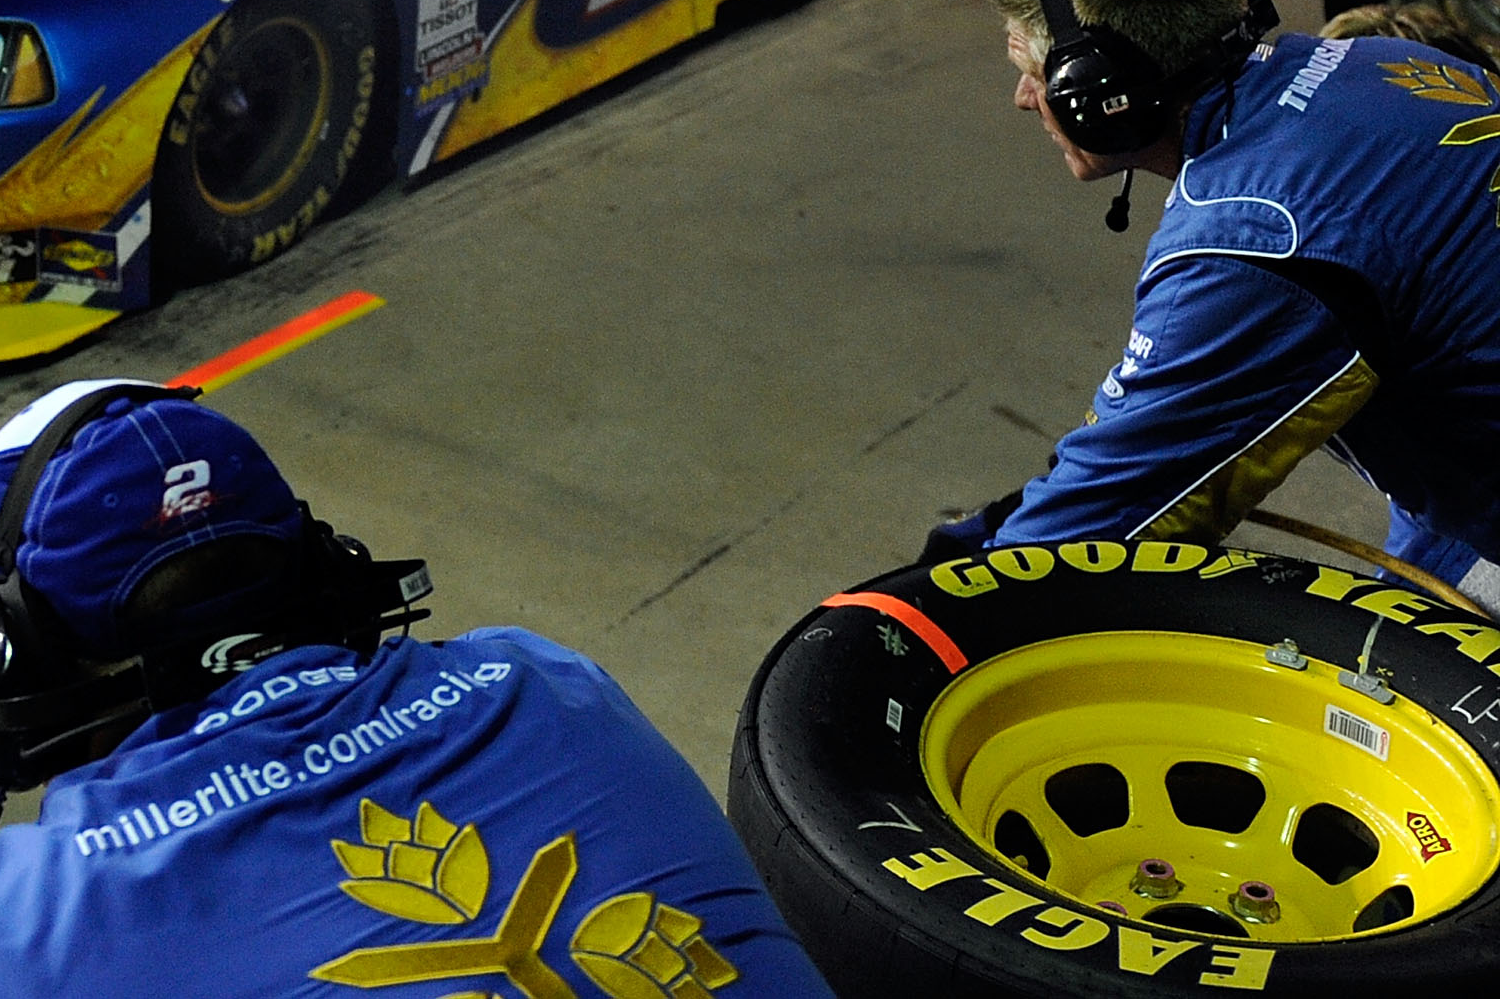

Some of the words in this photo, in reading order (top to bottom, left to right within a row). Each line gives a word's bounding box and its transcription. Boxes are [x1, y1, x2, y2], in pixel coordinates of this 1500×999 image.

[162, 459, 211, 517] 2
[193, 665, 358, 735] DODGE
[1409, 816, 1446, 853] AERO
[881, 847, 1277, 991] EAGLE
